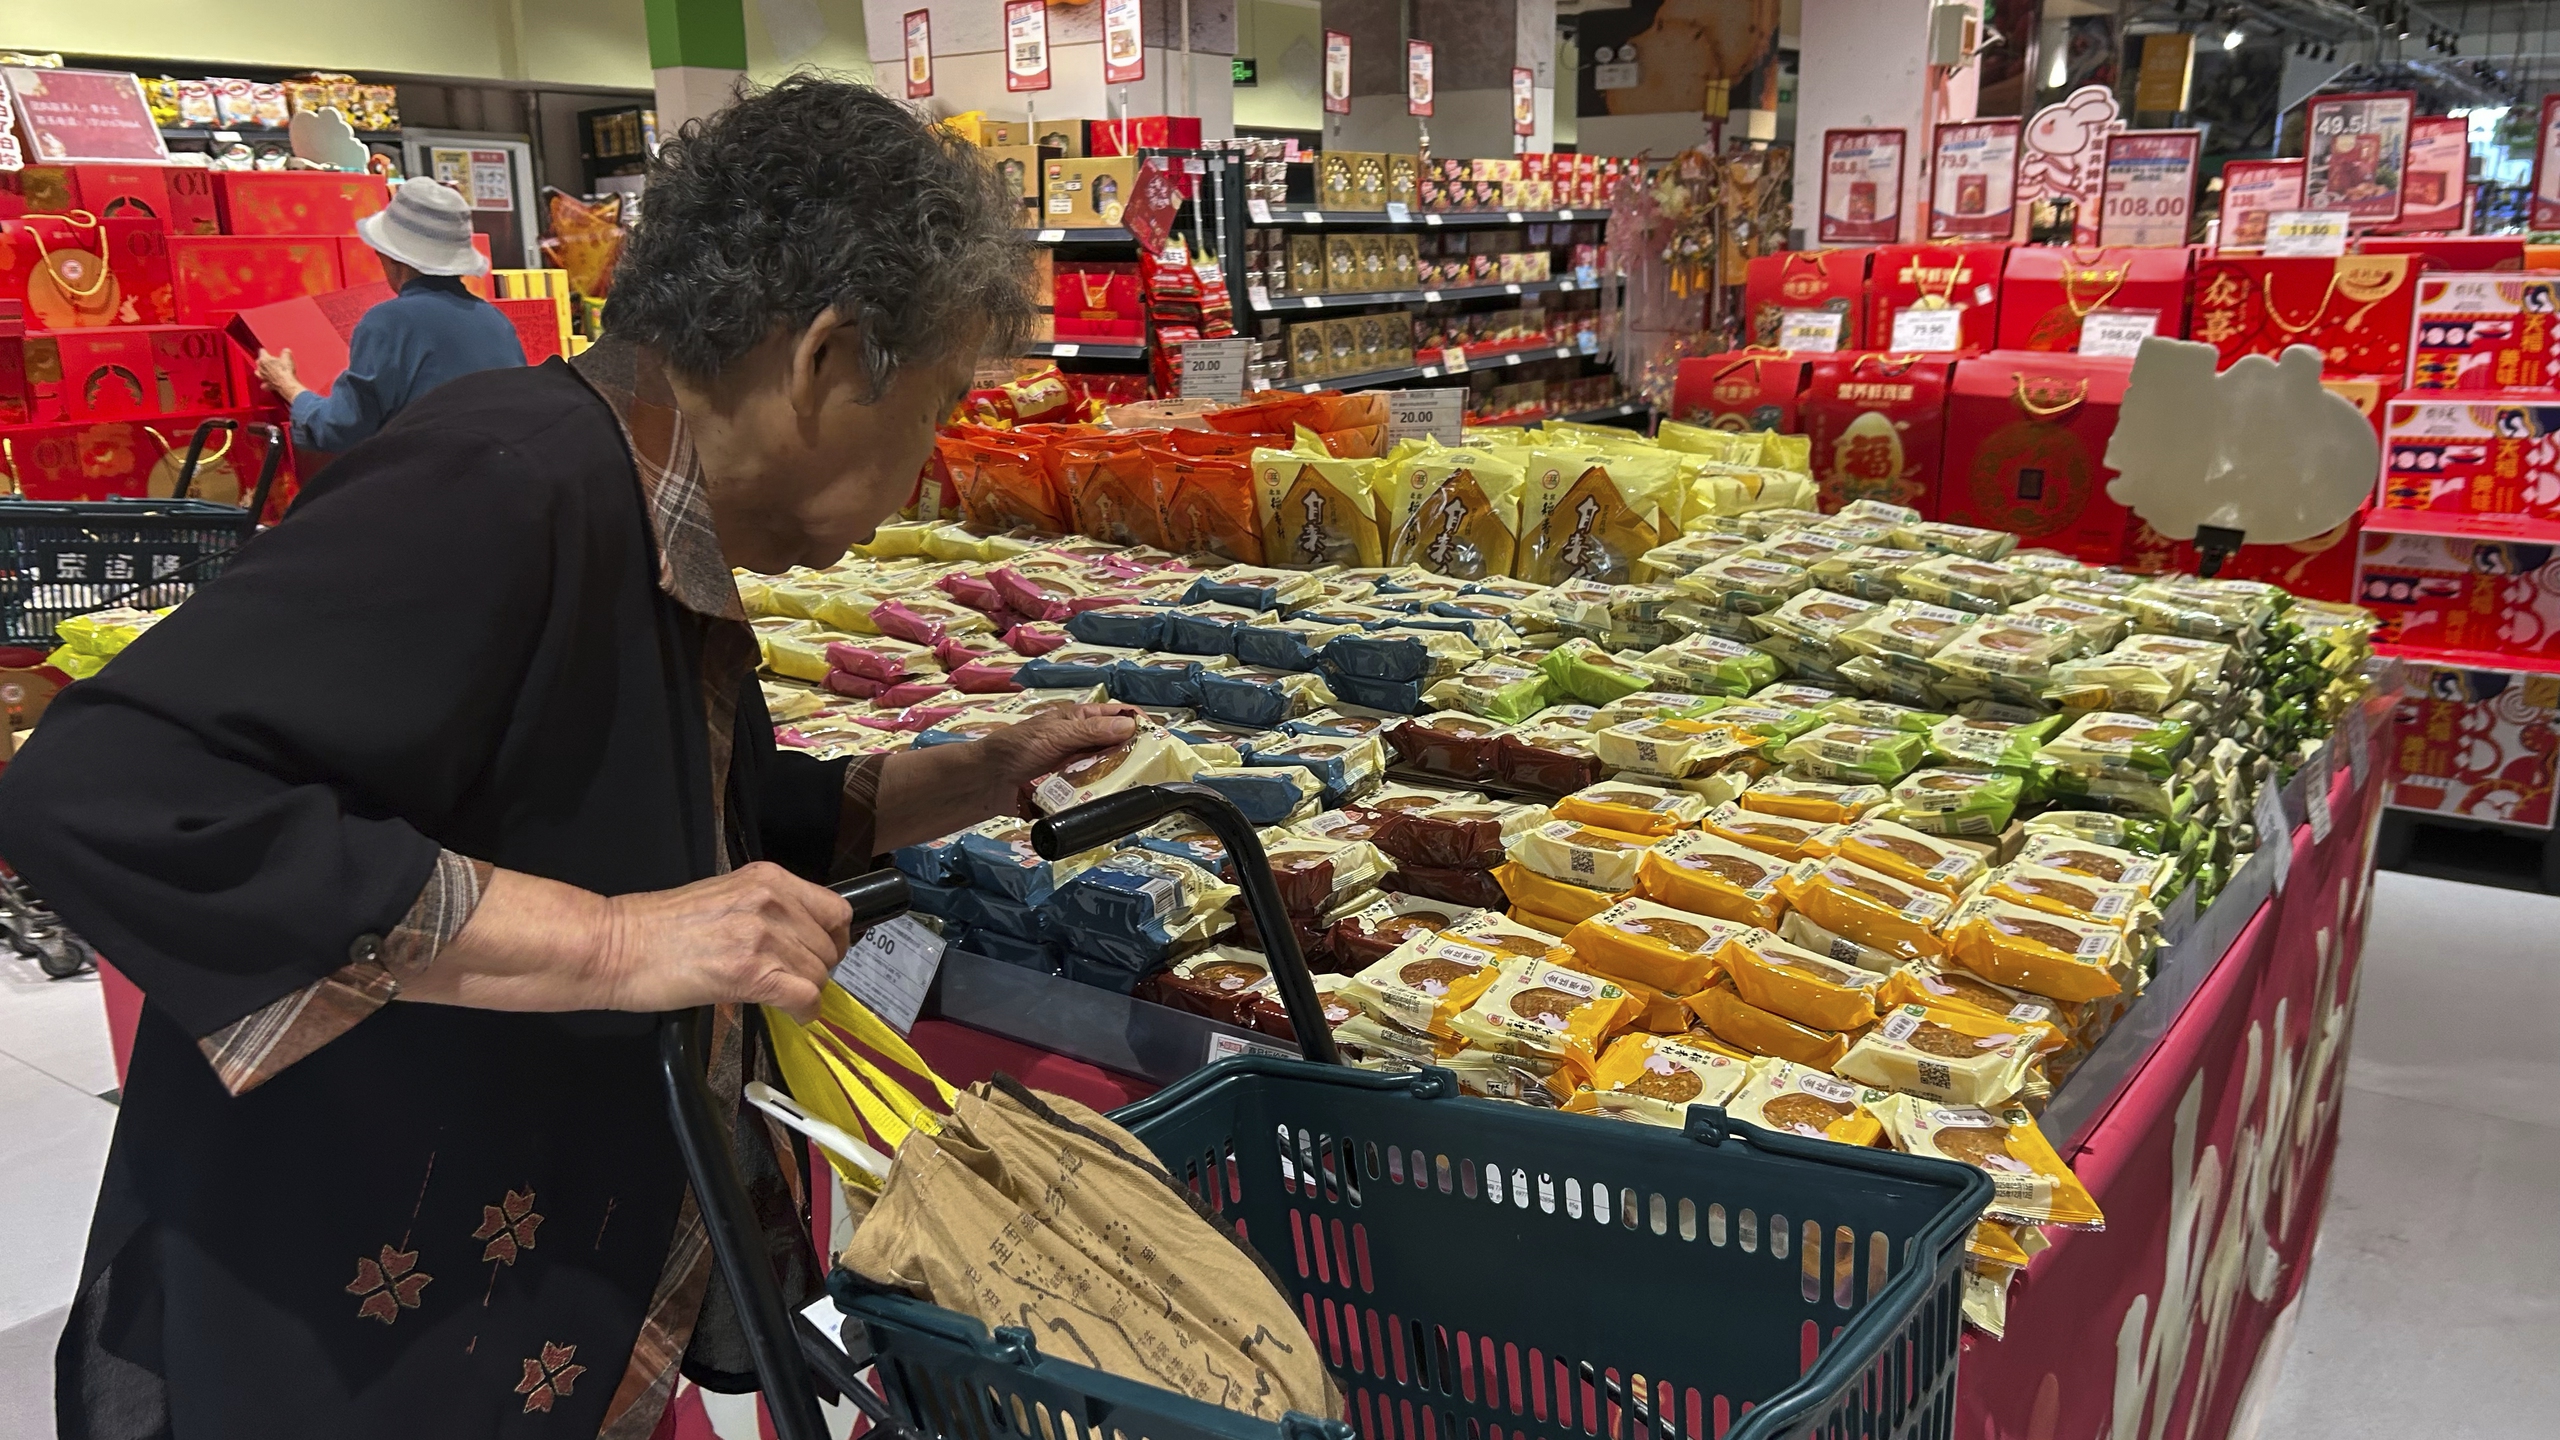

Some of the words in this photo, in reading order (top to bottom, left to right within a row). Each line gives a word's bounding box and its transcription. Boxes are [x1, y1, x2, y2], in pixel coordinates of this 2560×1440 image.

[2108, 197, 2185, 217] 108.00
[1192, 360, 1220, 371] 20.00
[1400, 411, 1433, 423] 20.00
